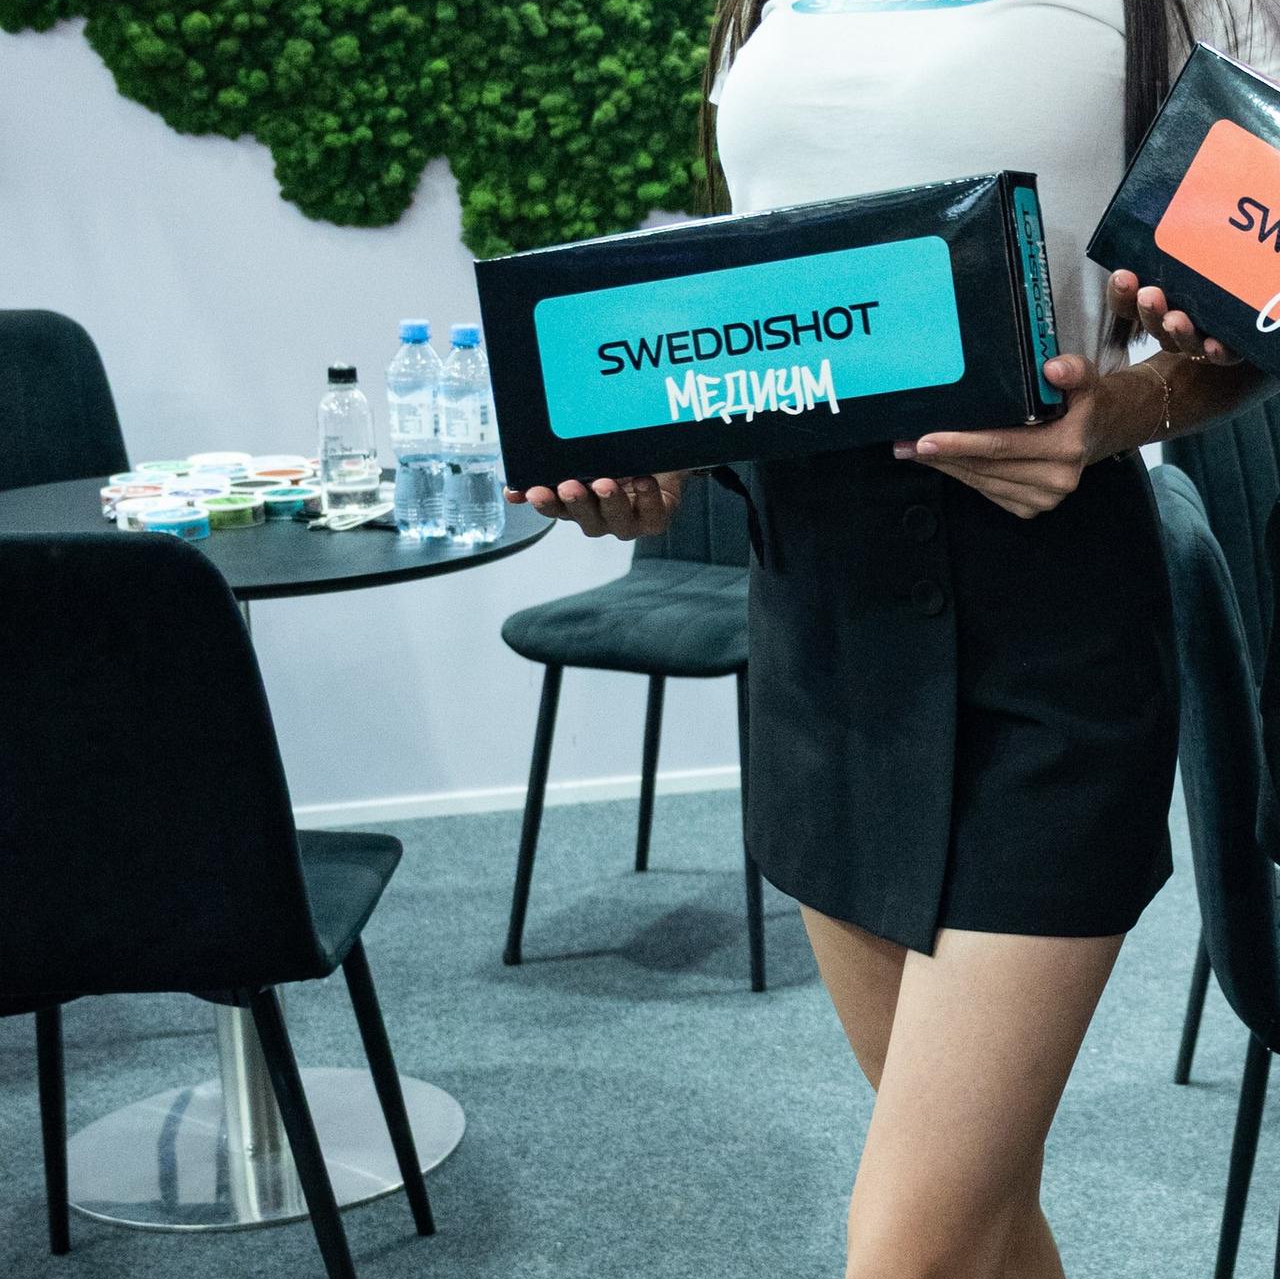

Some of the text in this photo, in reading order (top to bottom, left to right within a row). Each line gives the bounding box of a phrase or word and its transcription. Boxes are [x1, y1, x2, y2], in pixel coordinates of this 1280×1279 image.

[1021, 201, 1050, 364] WEDDISHOT
[597, 300, 880, 376] SWEDDISHOT
[664, 358, 841, 425] МЕДИУМ
